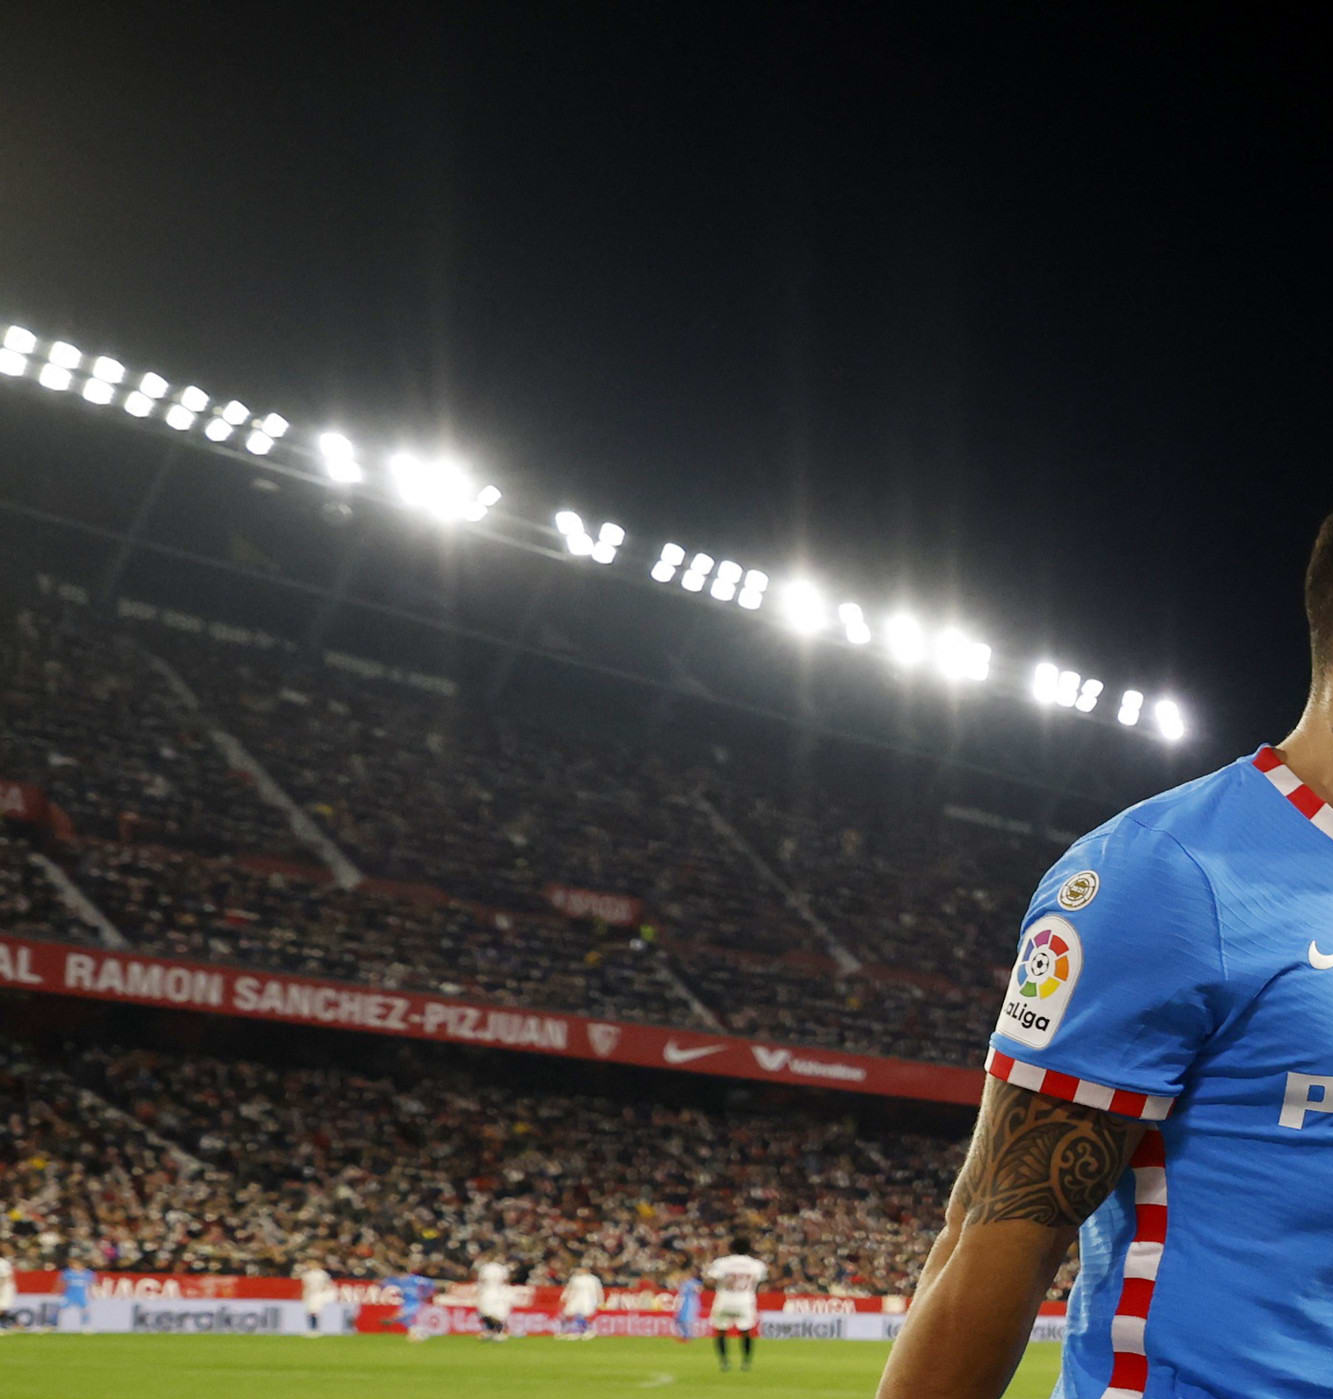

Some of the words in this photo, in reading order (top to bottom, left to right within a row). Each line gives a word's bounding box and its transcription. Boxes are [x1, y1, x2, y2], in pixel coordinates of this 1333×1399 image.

[64, 952, 223, 1007] RAMON
[233, 976, 568, 1050] SANCHEZ-PIZJUAN
[1005, 1002, 1050, 1031] aLiga
[132, 1304, 281, 1332] kerakoll
